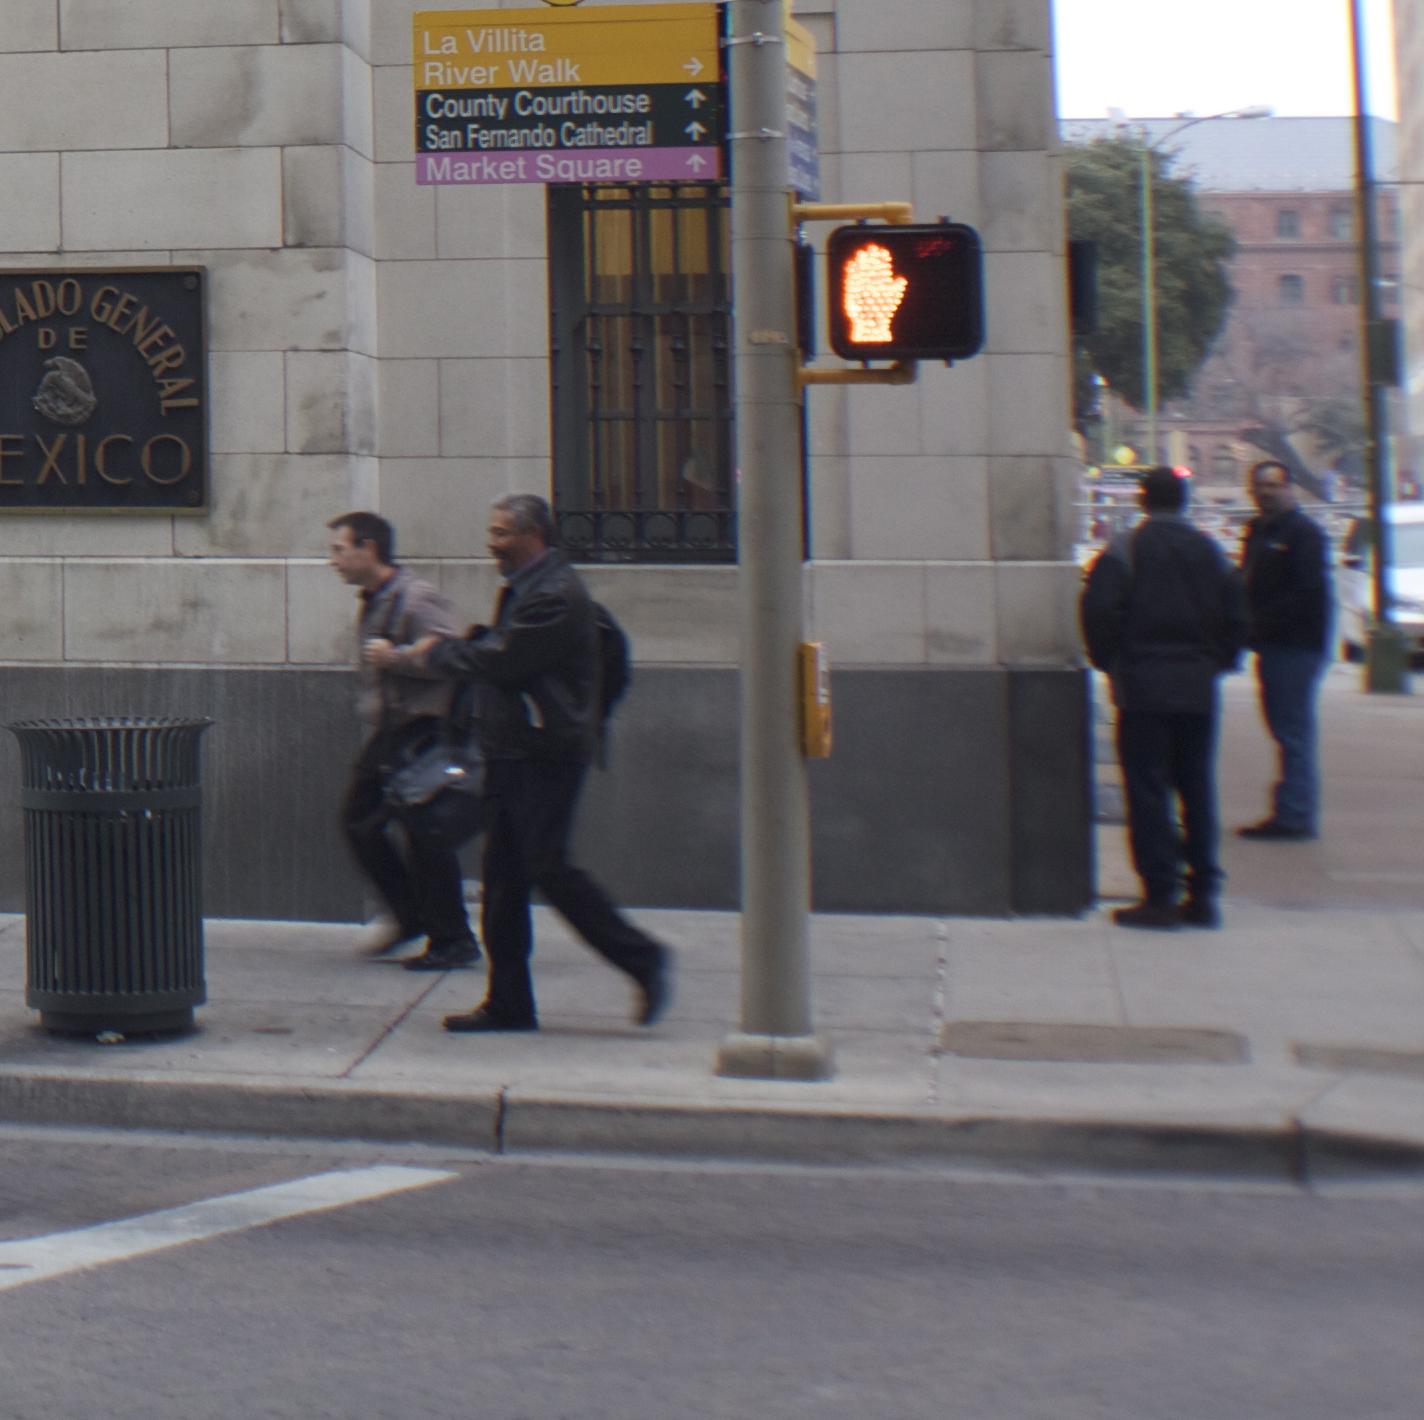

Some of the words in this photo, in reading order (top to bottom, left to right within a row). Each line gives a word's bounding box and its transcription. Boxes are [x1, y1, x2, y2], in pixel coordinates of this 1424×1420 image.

[423, 30, 457, 55] La
[465, 28, 546, 53] Villita
[423, 61, 499, 85] River
[508, 58, 581, 83] Walk
[425, 92, 509, 120] County
[514, 89, 651, 114] Courthouse
[425, 124, 463, 150] San
[466, 122, 556, 149] Fernando
[560, 120, 654, 147] Cathedral
[426, 155, 526, 181] Market
[536, 153, 643, 181] Square
[38, 327, 88, 349] DE
[90, 285, 199, 416] GENERAL
